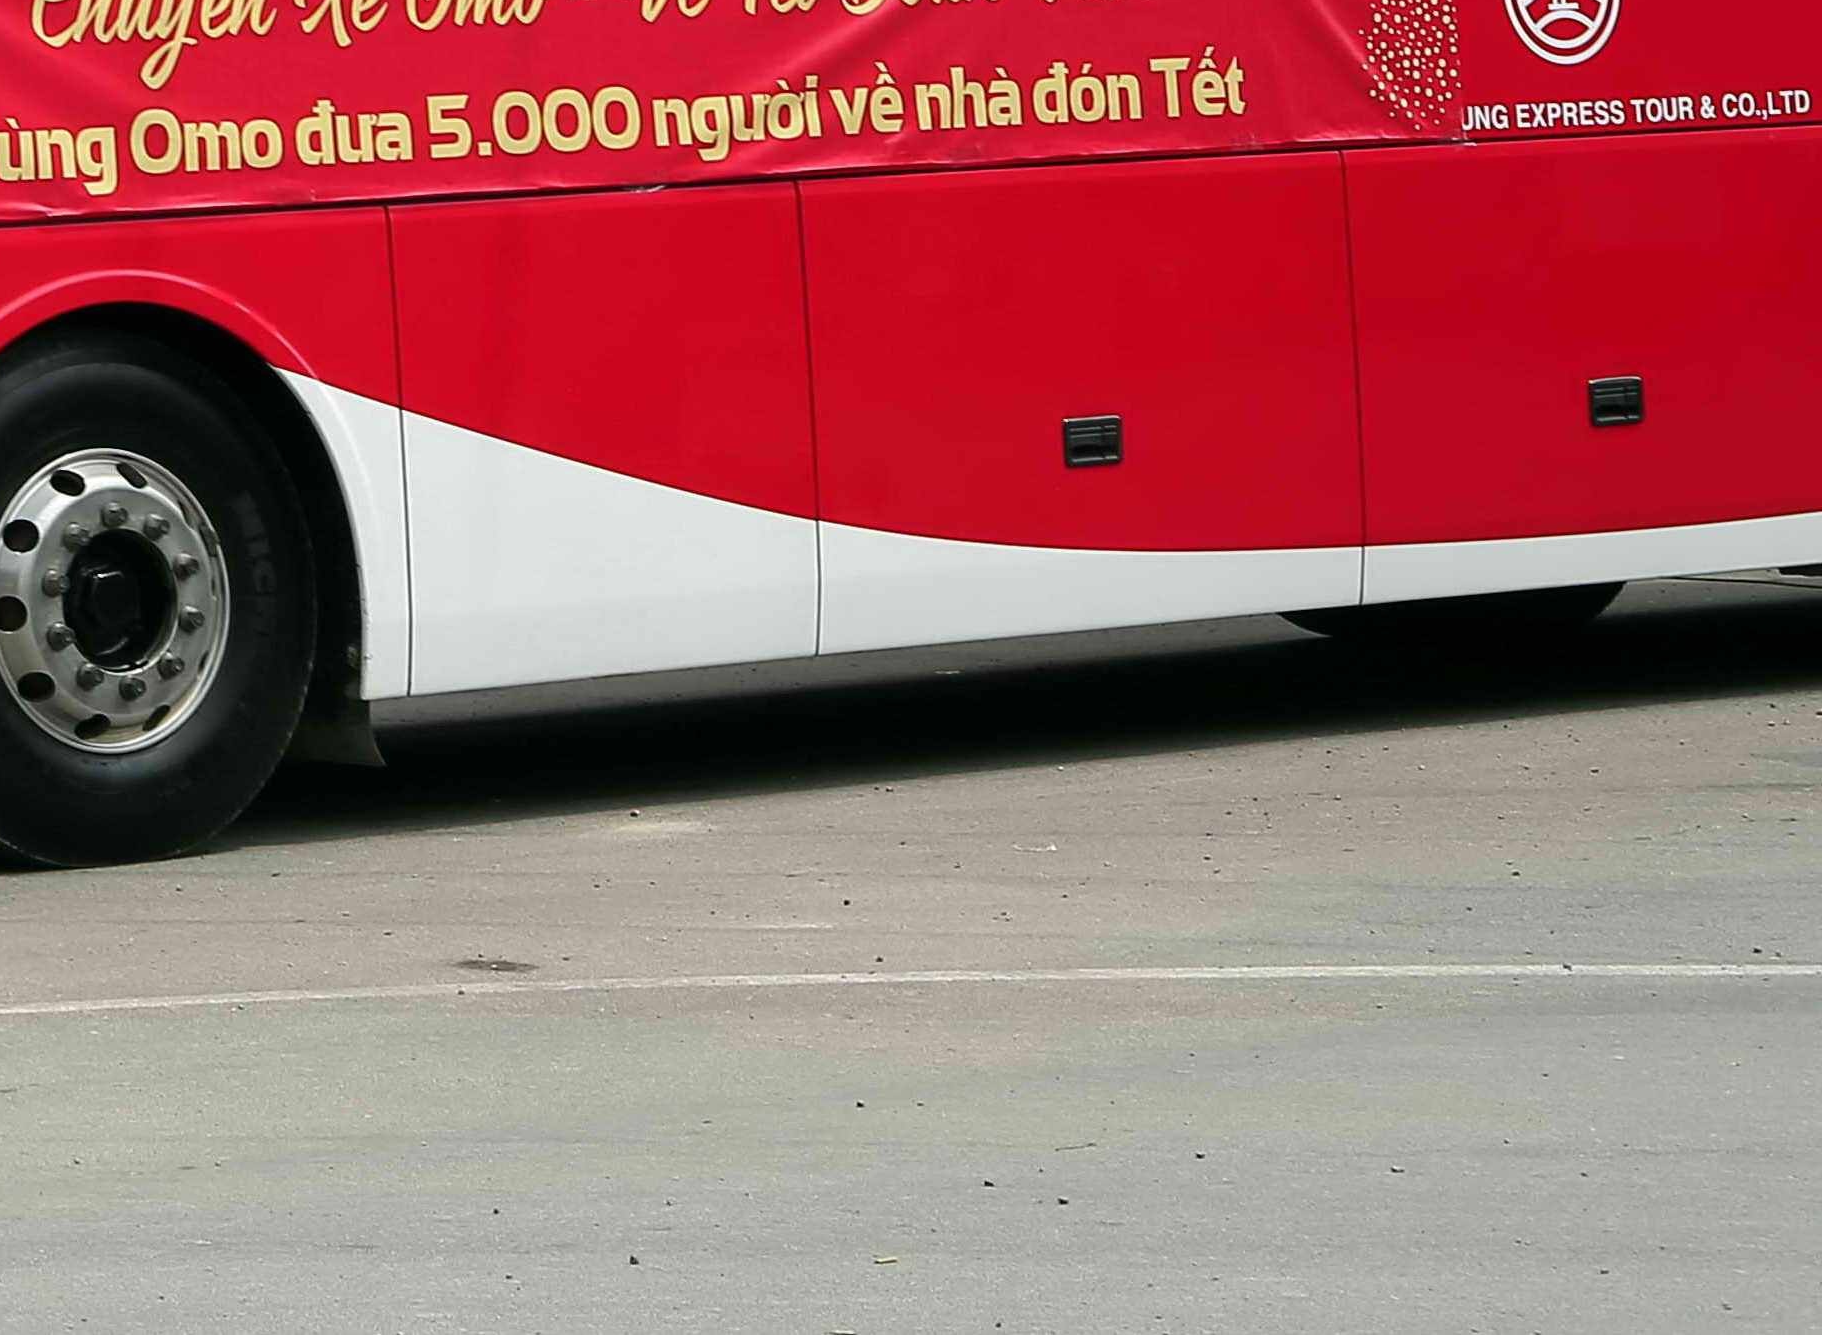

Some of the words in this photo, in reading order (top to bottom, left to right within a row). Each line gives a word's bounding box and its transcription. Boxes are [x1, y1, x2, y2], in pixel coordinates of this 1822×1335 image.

[130, 108, 283, 174] Omo
[295, 98, 413, 165] đưa
[427, 86, 641, 159] 5.000
[652, 74, 822, 162] người
[829, 61, 904, 135] về
[914, 66, 1023, 131] nhà
[1033, 61, 1142, 124] đón
[1149, 45, 1247, 118] Tết
[1515, 99, 1625, 128] EXPRESS
[1630, 96, 1695, 123] TOUR
[1700, 95, 1717, 119] &
